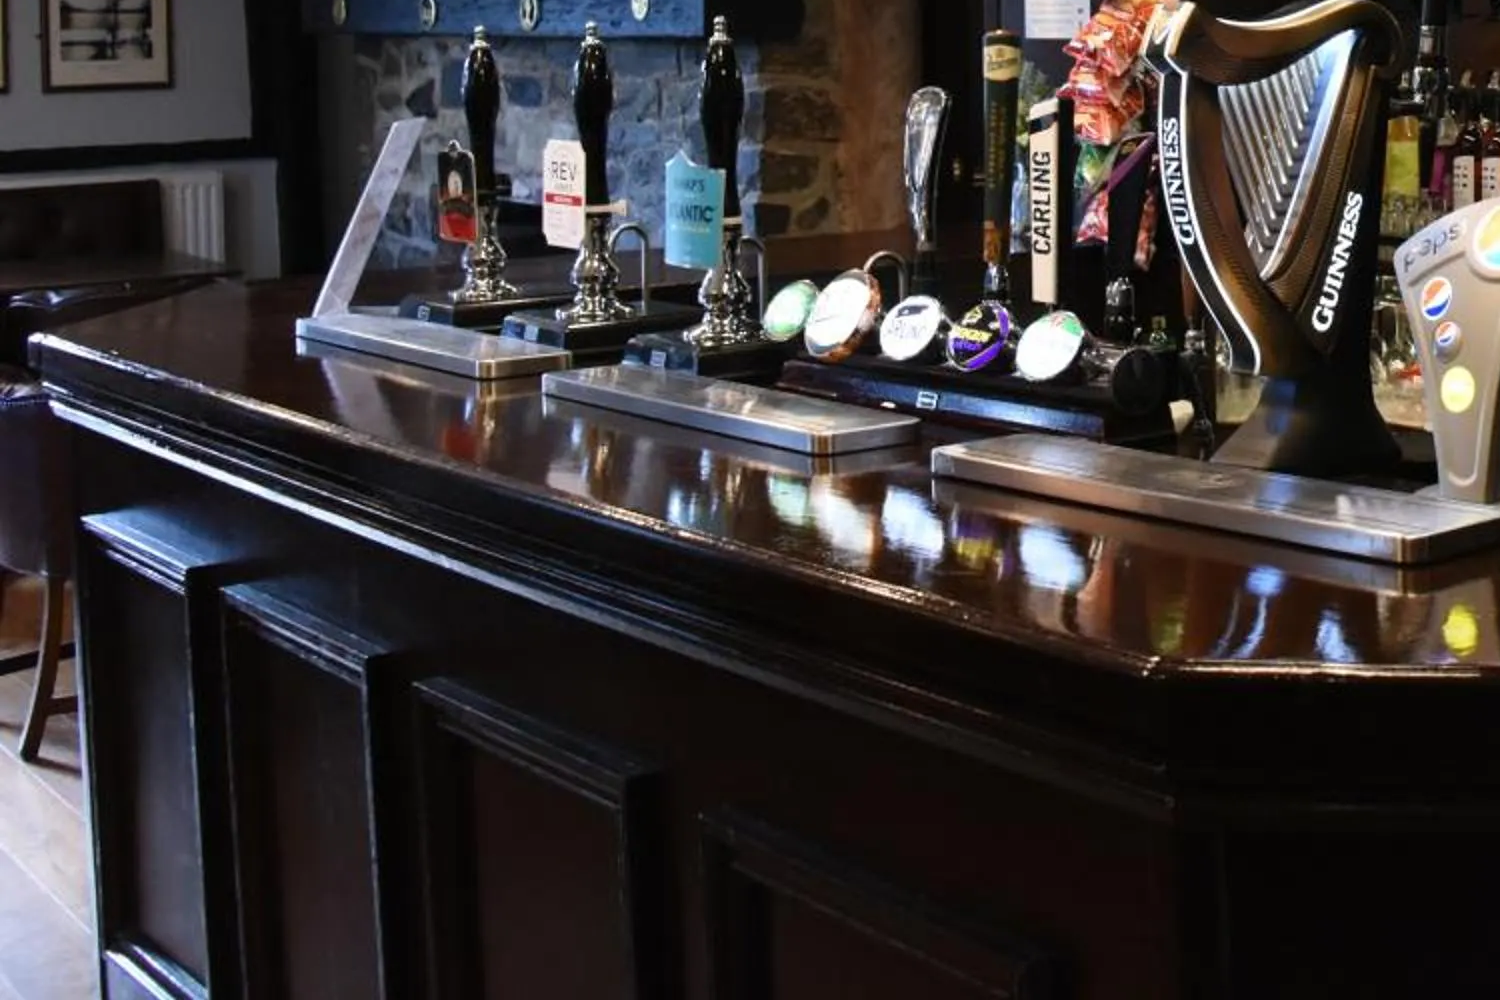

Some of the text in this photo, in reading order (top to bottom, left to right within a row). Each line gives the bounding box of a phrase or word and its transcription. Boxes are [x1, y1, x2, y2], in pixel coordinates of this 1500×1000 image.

[551, 161, 578, 181] REV
[1033, 151, 1051, 255] CARLING
[1163, 117, 1195, 246] GUINNESS
[1311, 191, 1363, 332] GUINNESS
